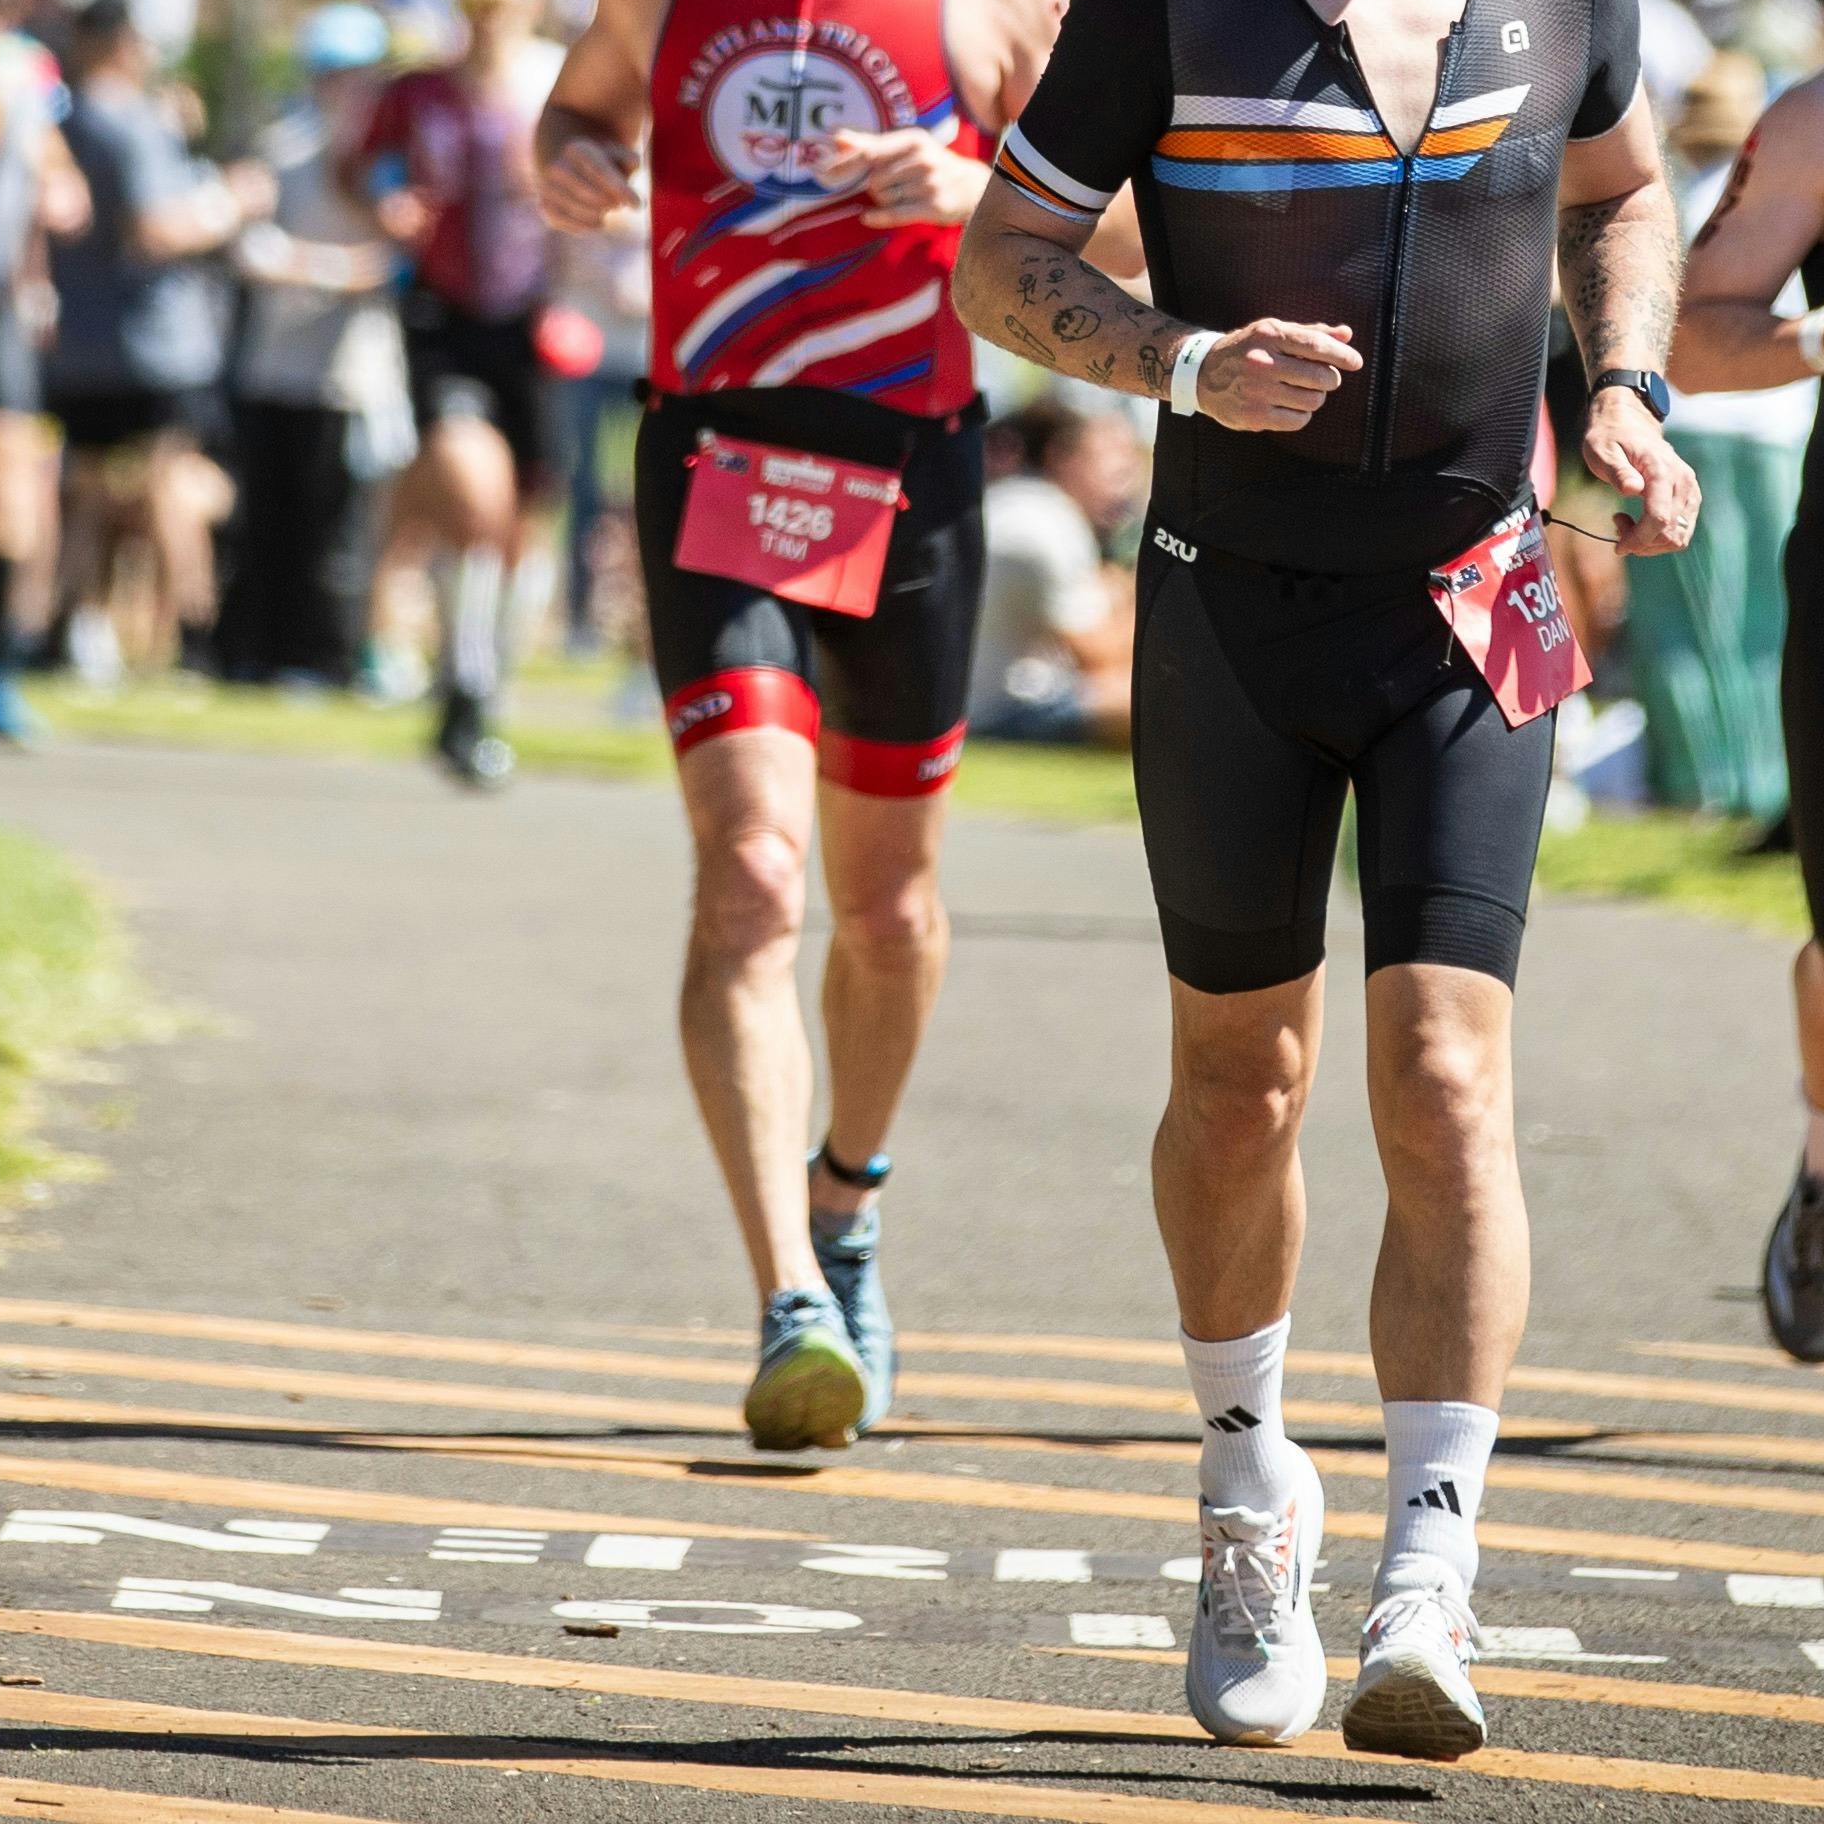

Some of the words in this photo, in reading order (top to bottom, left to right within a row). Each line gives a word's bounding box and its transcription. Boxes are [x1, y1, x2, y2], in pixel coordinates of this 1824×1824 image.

[746, 489, 834, 540] 1426
[758, 529, 810, 564] TIM
[1153, 527, 1198, 563] 2XU
[1538, 617, 1570, 652] DAN
